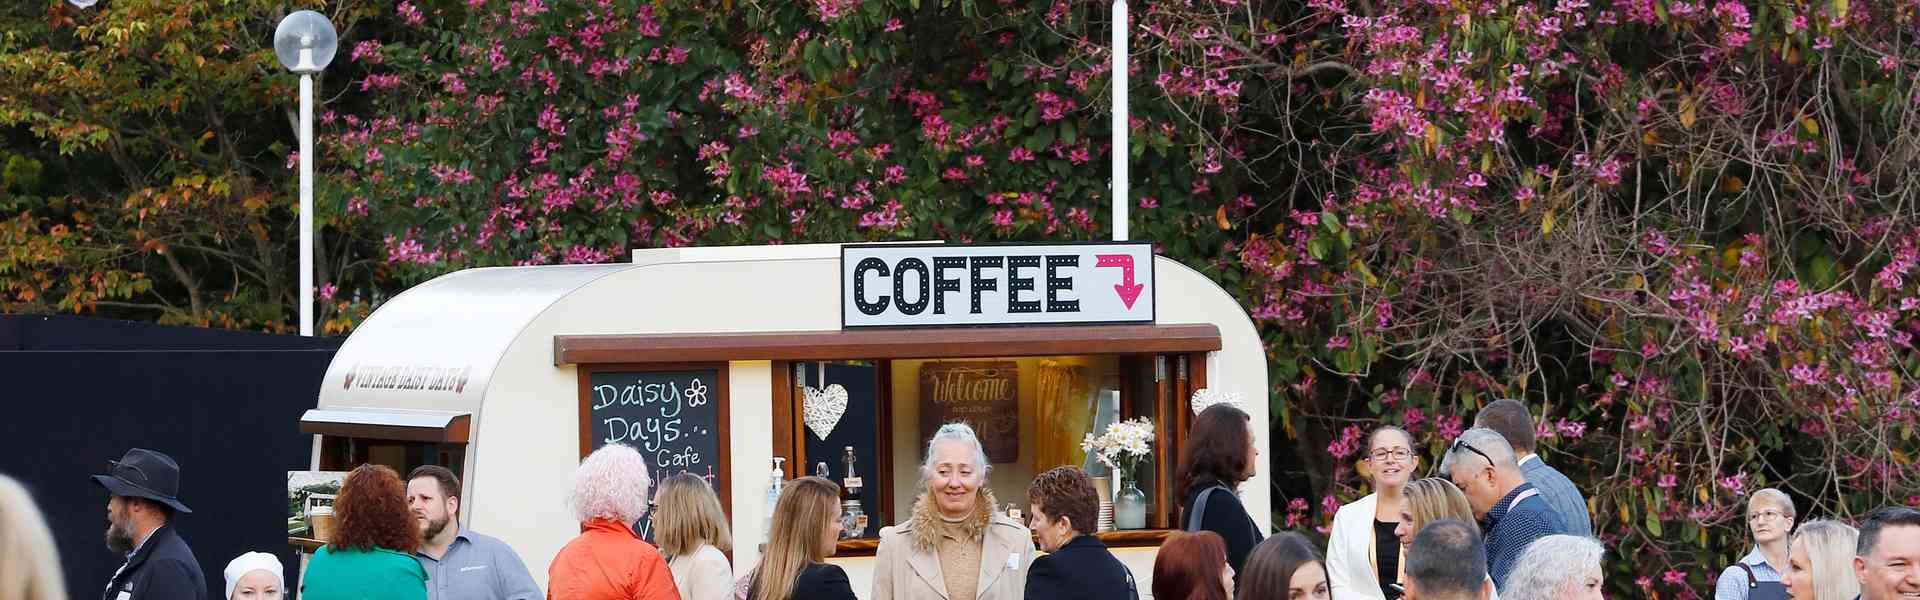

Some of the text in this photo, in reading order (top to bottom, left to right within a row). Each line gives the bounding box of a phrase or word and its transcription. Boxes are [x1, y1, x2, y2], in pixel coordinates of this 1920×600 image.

[853, 254, 1081, 316] COFFEE
[356, 367, 398, 390] VINTAGE
[932, 367, 1010, 403] Welcome
[593, 379, 681, 417] Daisy
[656, 446, 701, 468] Cafe
